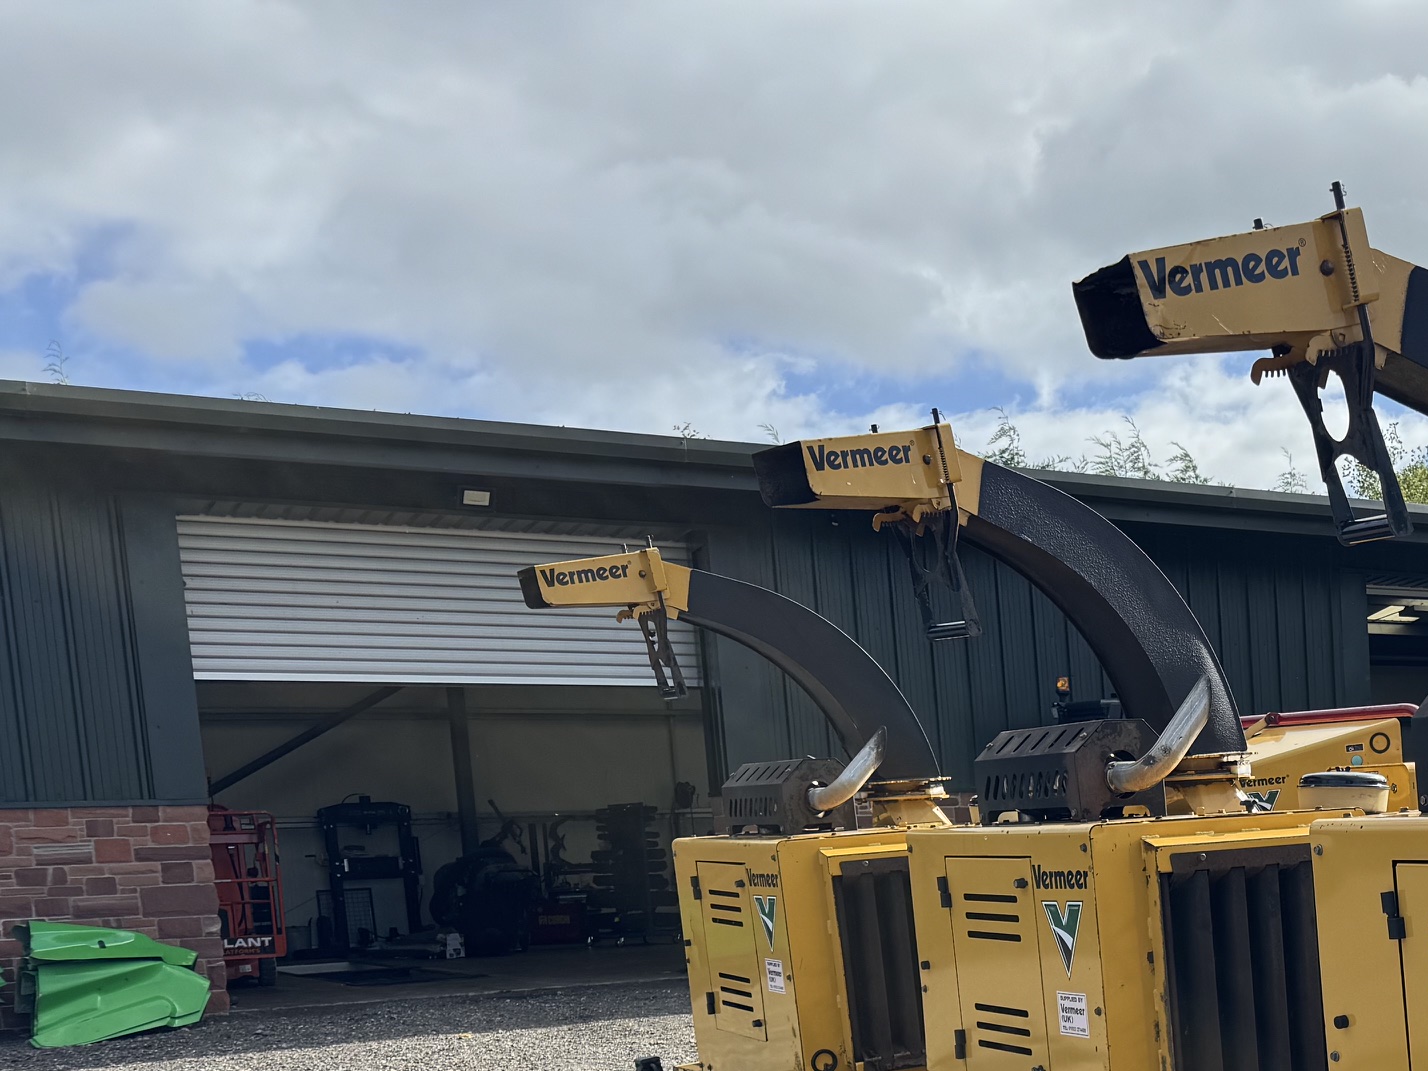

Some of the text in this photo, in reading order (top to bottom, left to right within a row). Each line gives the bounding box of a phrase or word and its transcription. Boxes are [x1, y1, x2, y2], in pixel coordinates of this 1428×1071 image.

[1137, 245, 1302, 300] Vermeer
[806, 444, 912, 472] Vermeer
[539, 564, 629, 588] Vermeer
[745, 867, 779, 888] Vermeer
[1031, 864, 1089, 890] Vermeer
